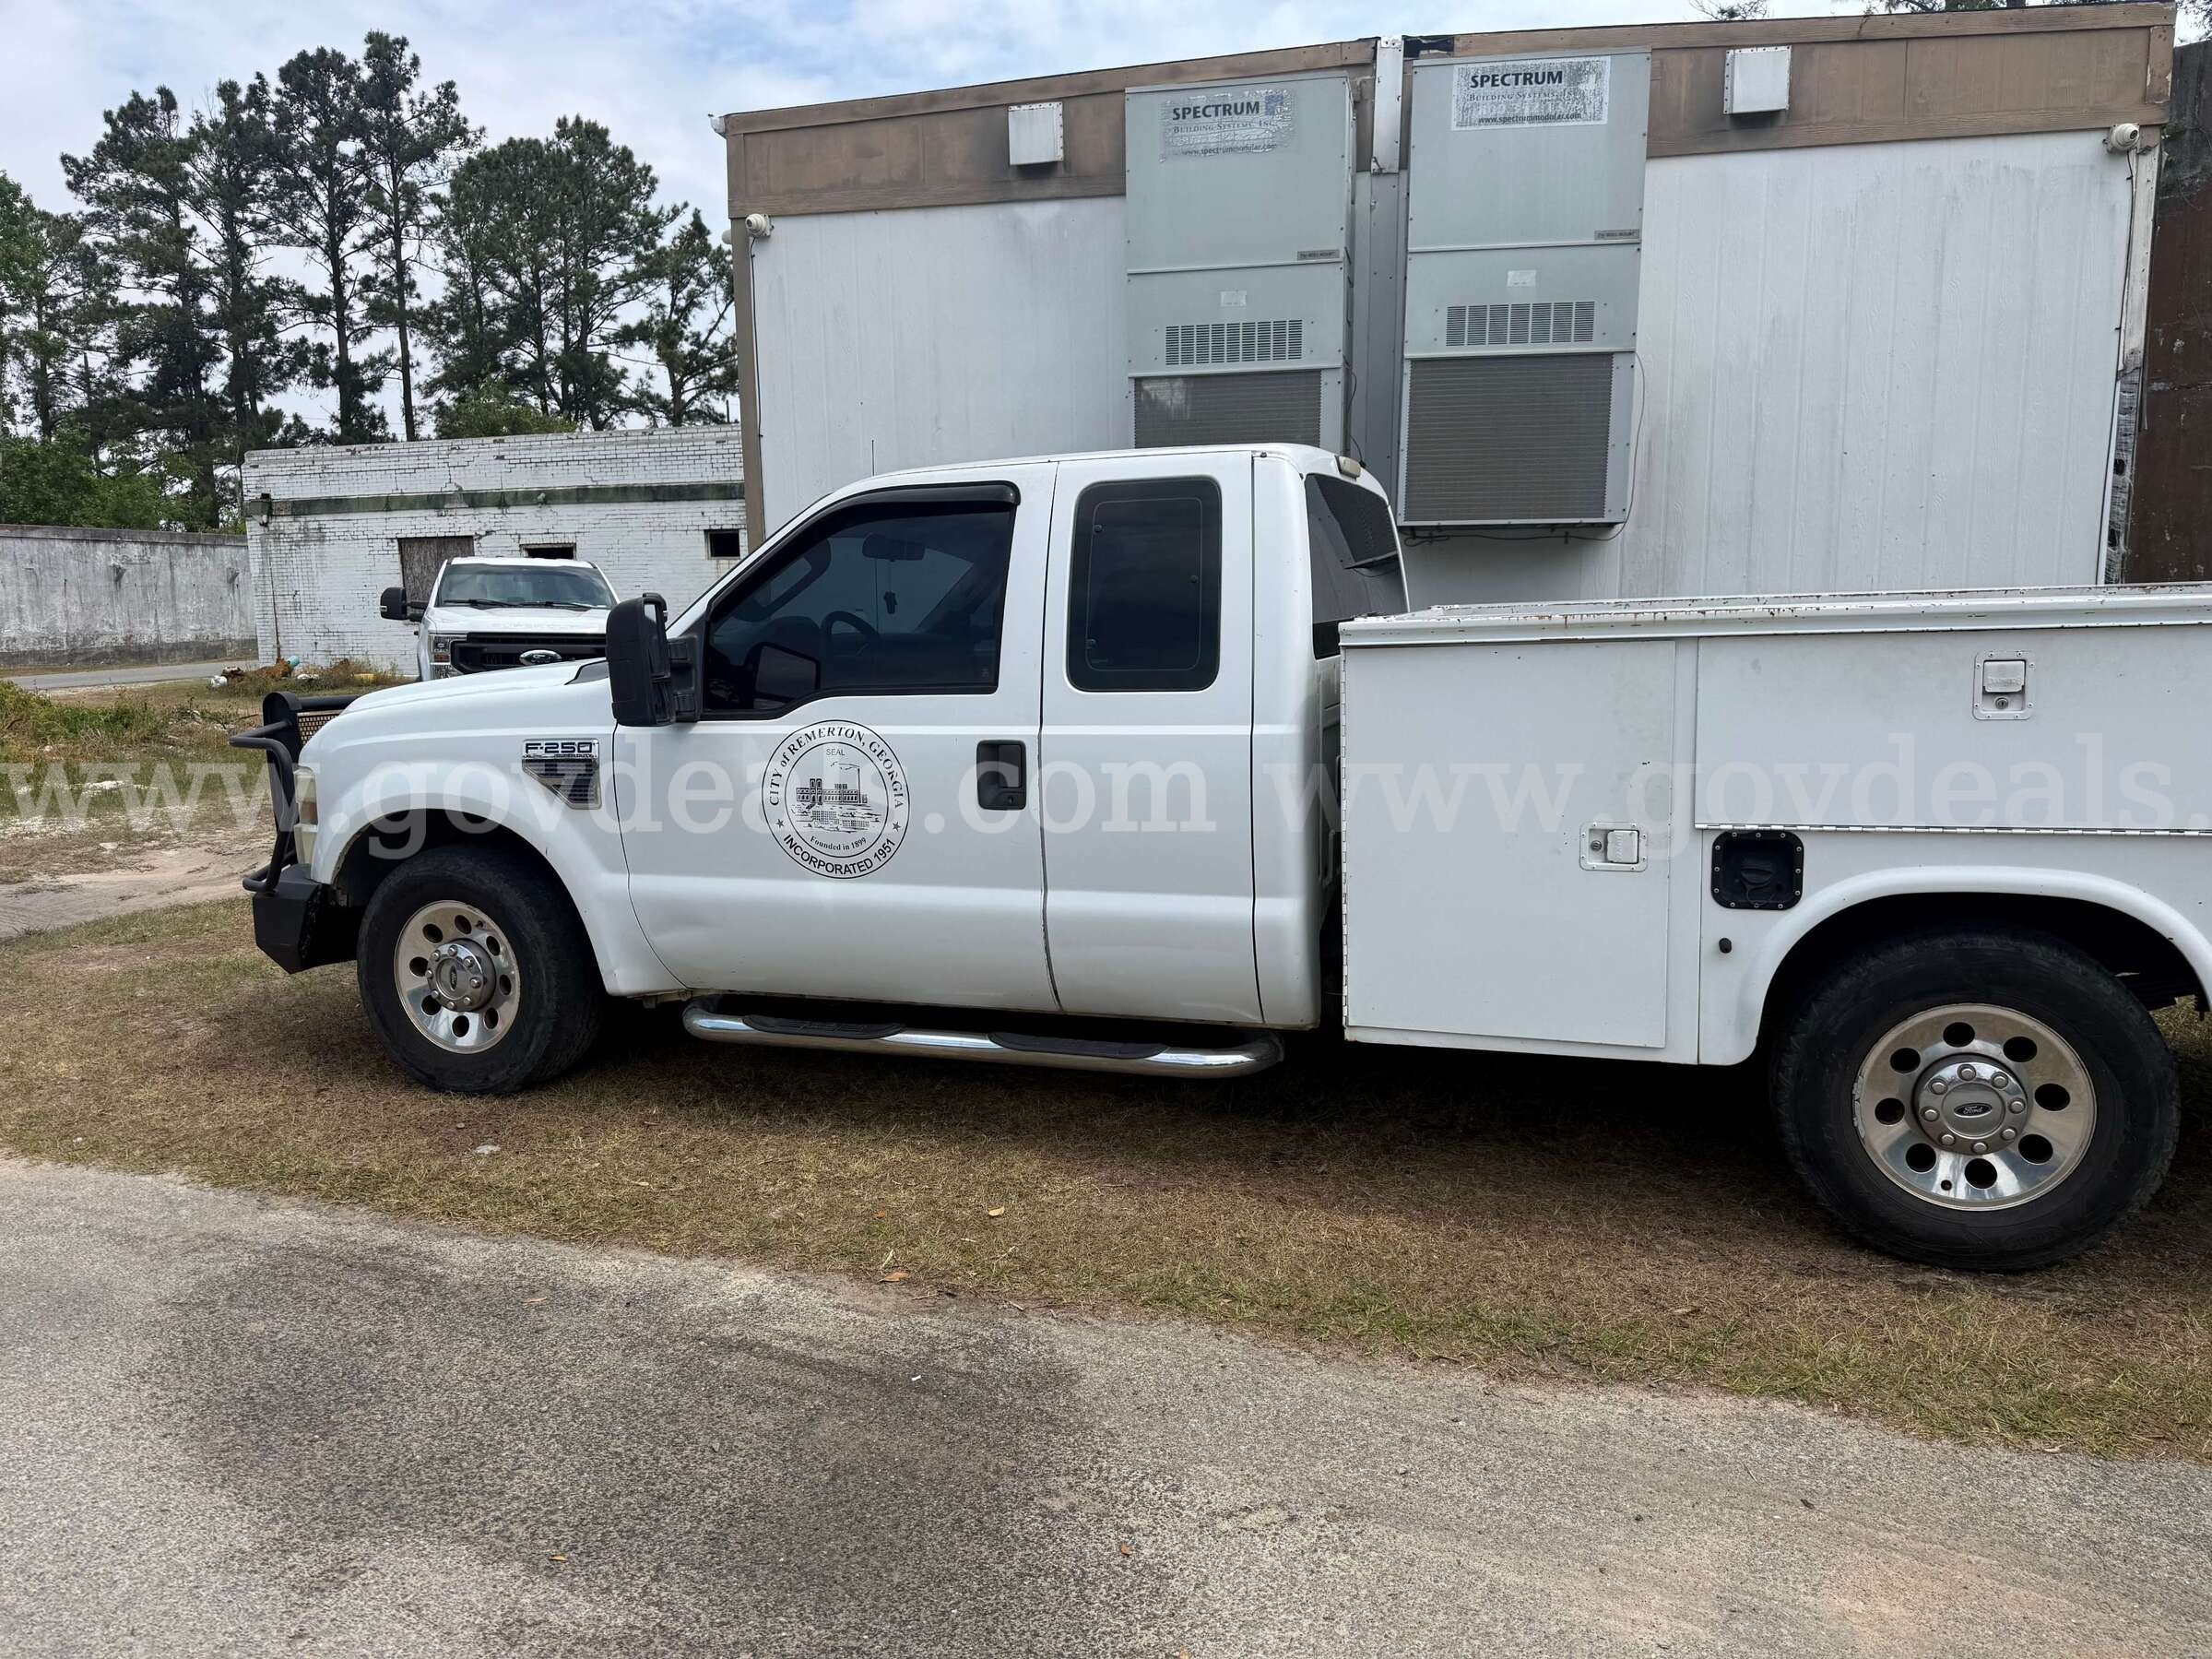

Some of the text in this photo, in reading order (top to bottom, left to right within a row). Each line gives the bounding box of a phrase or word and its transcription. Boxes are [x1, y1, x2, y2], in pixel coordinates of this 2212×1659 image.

[1470, 70, 1563, 89] SPECTRUM
[1172, 101, 1260, 120] SPECTRUM
[526, 741, 592, 753] F-250
[826, 748, 846, 756] SEAL
[769, 727, 904, 809] CITY of REMERTON, GEORGIA
[810, 835, 841, 851] Founded
[851, 836, 867, 849] 1899
[784, 834, 896, 875] INCORPORATED 1951
[1963, 1106, 1983, 1115] Ford
